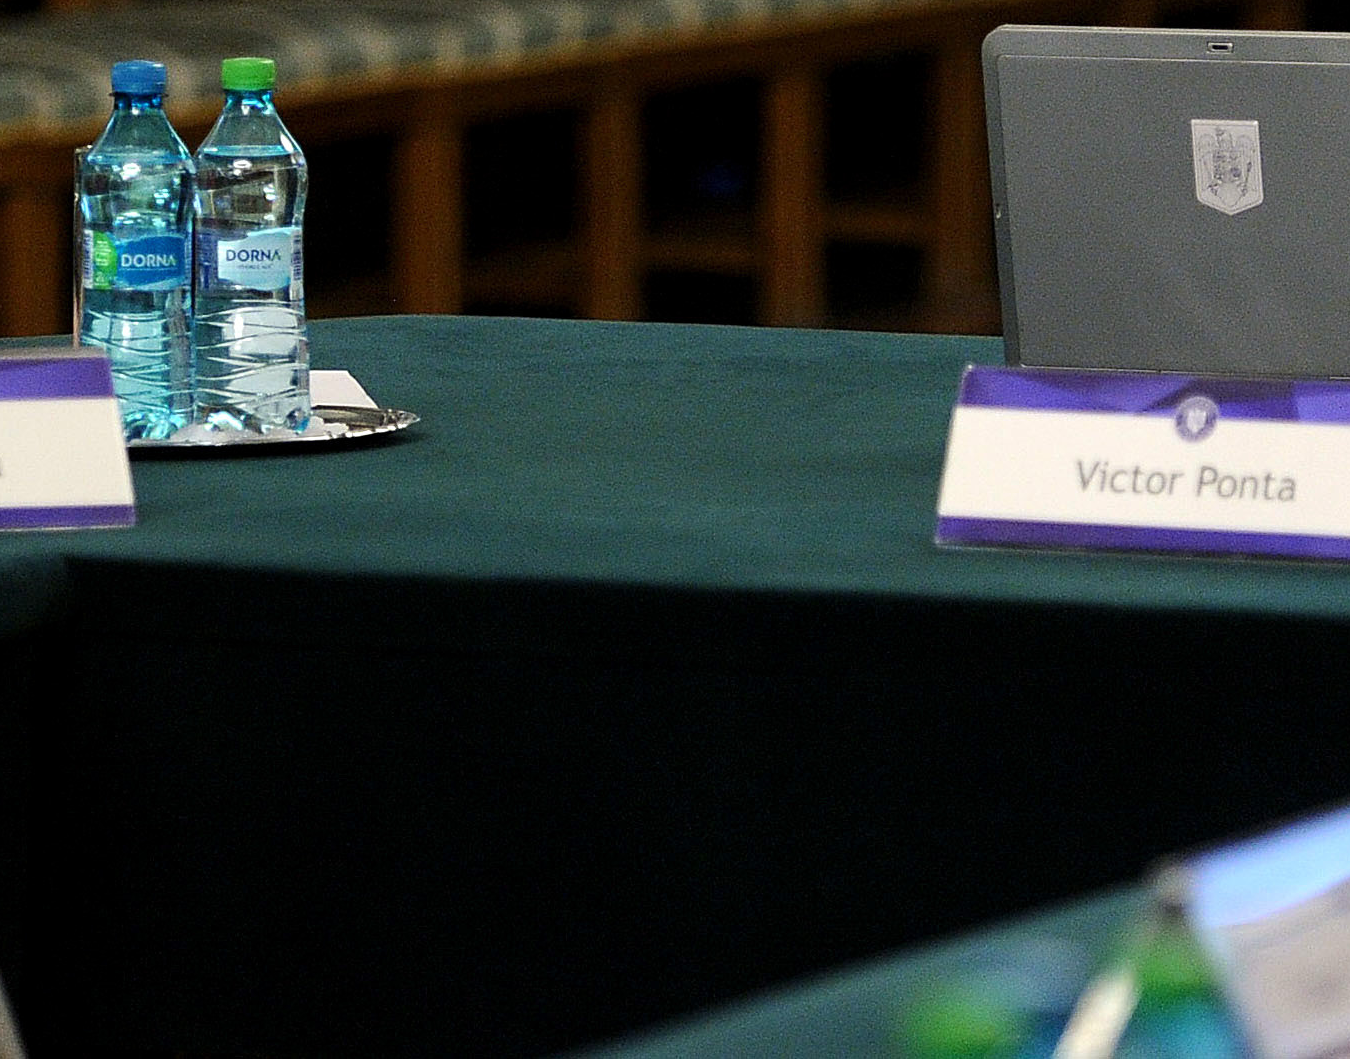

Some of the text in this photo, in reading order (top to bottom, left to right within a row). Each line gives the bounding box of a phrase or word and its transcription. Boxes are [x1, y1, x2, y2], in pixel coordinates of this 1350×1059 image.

[120, 253, 177, 268] DORNA
[225, 249, 281, 262] DORNA
[1076, 459, 1297, 502] Victor Ponta
